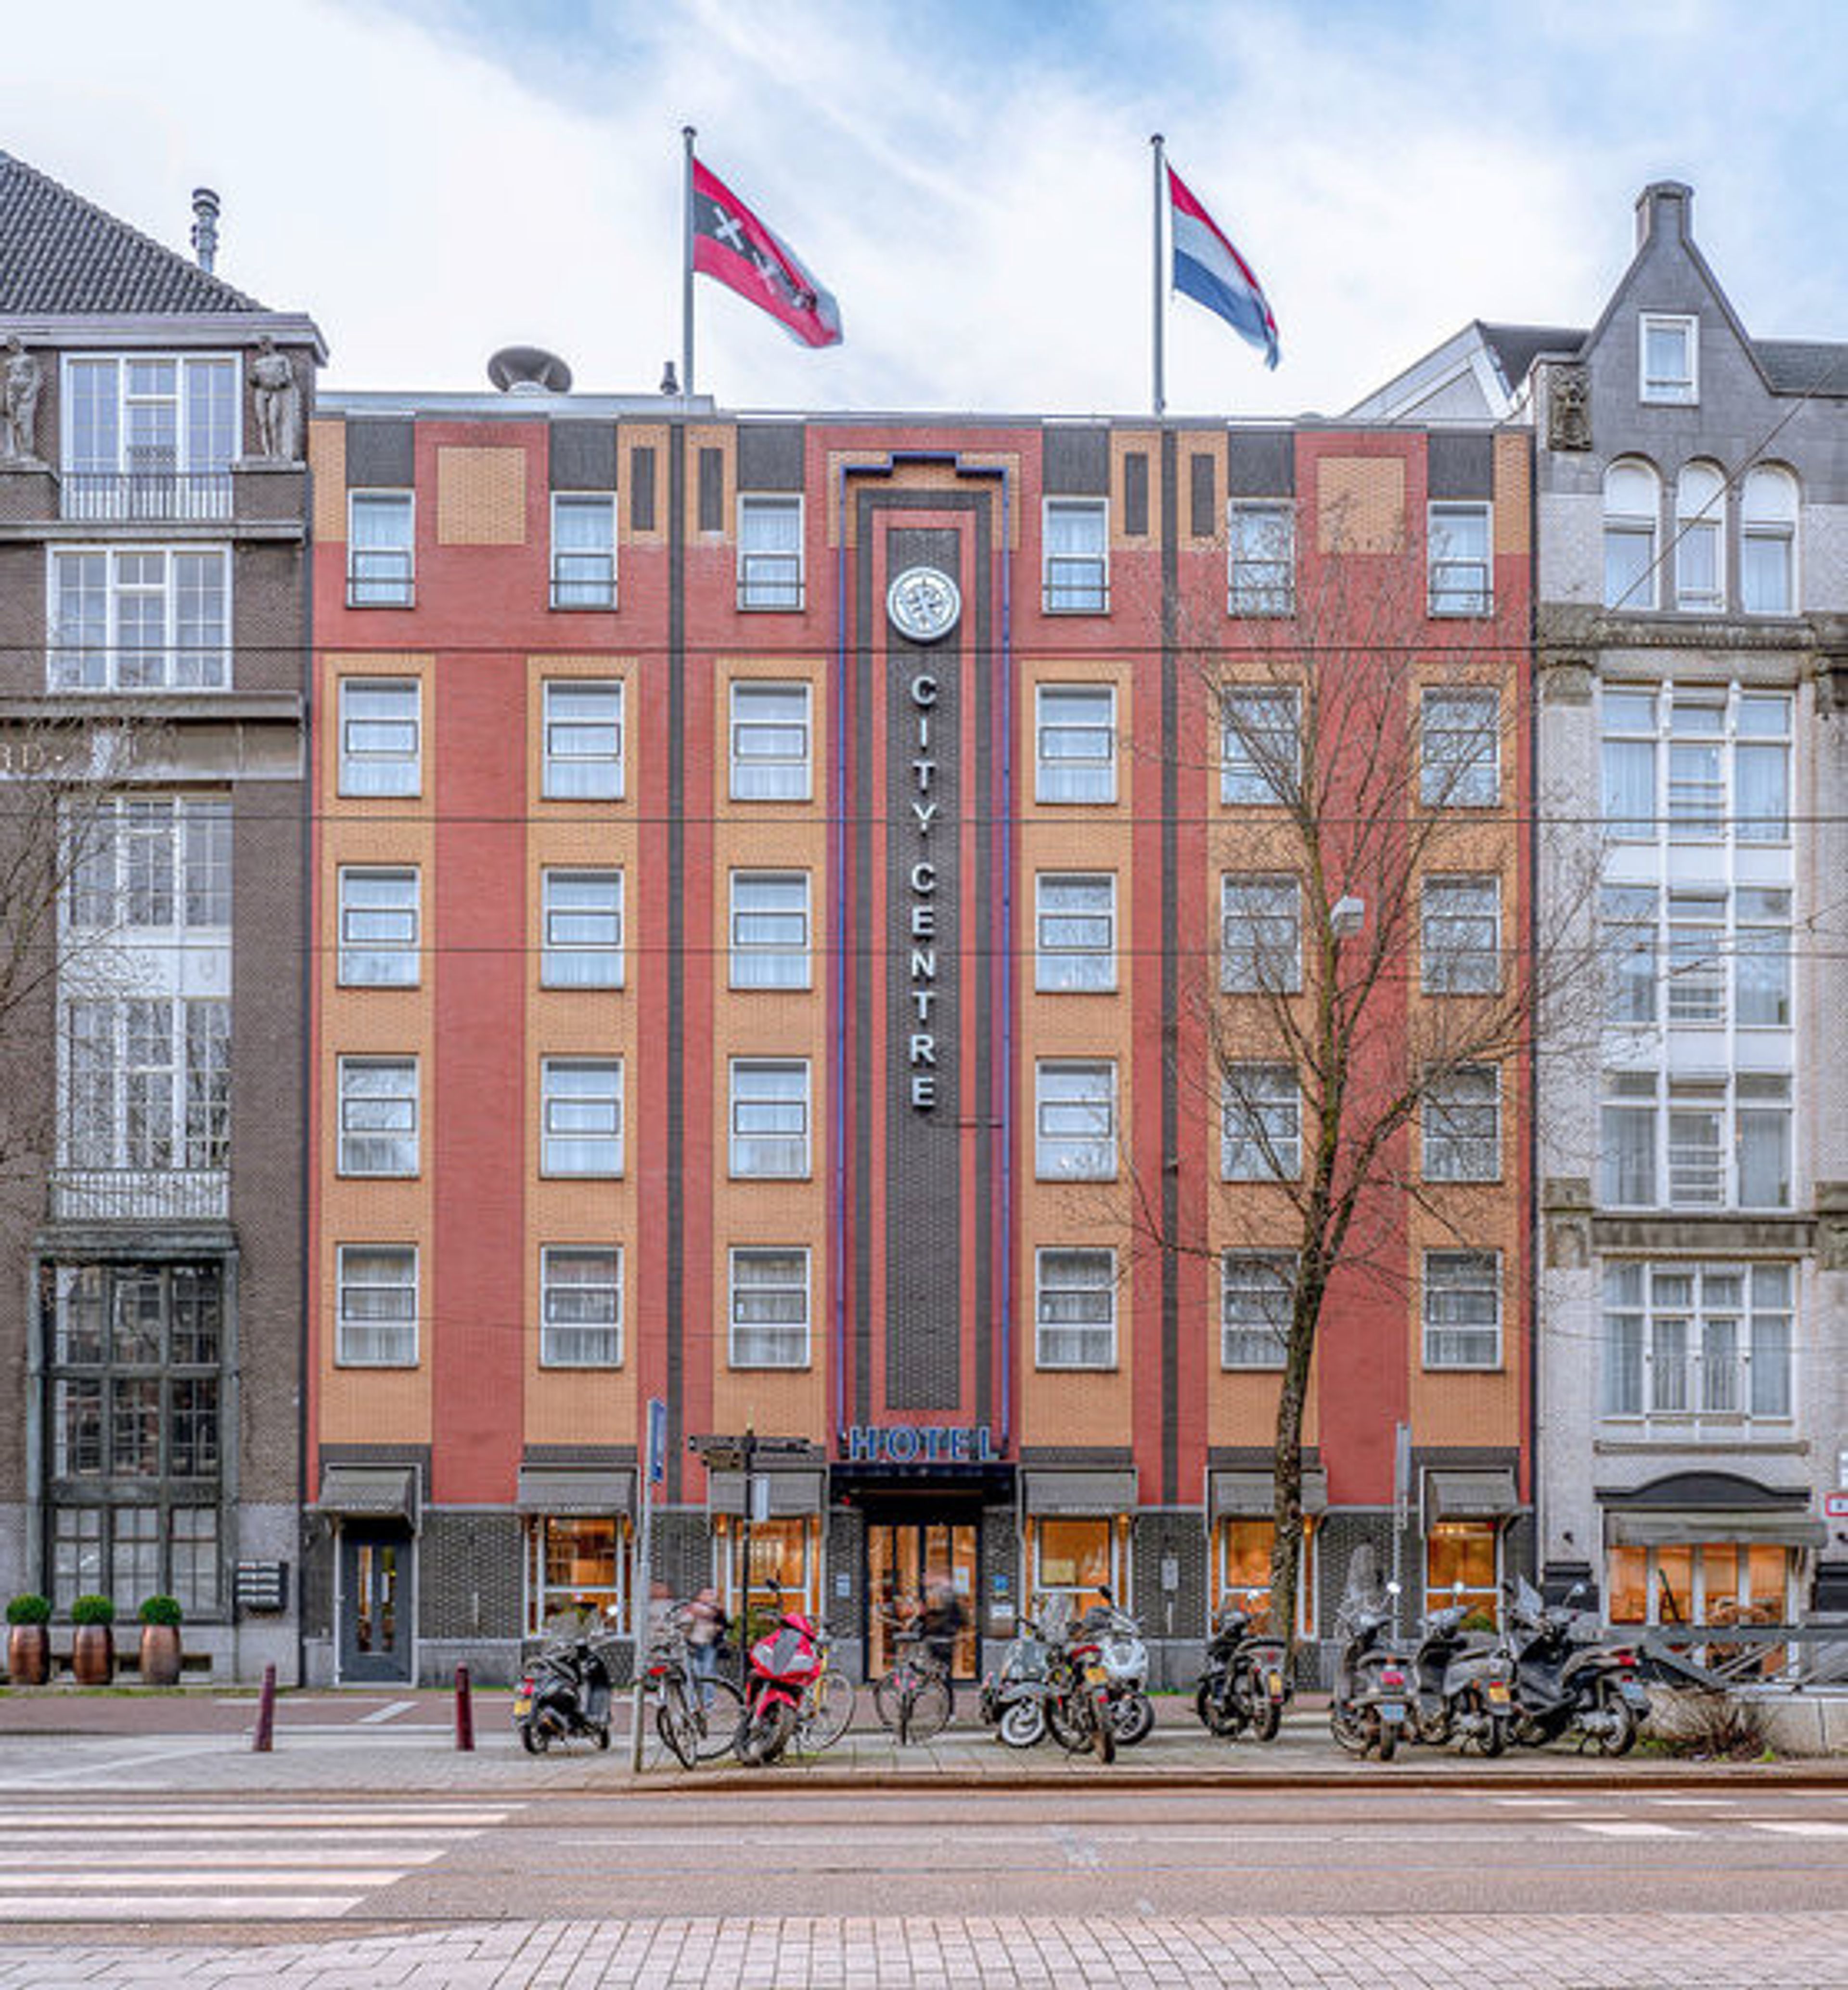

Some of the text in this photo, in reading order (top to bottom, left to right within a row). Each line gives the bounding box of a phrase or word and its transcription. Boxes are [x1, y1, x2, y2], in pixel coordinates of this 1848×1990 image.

[910, 675, 937, 1107] CITY CENTRE
[849, 1426, 1000, 1461] HOTEL
